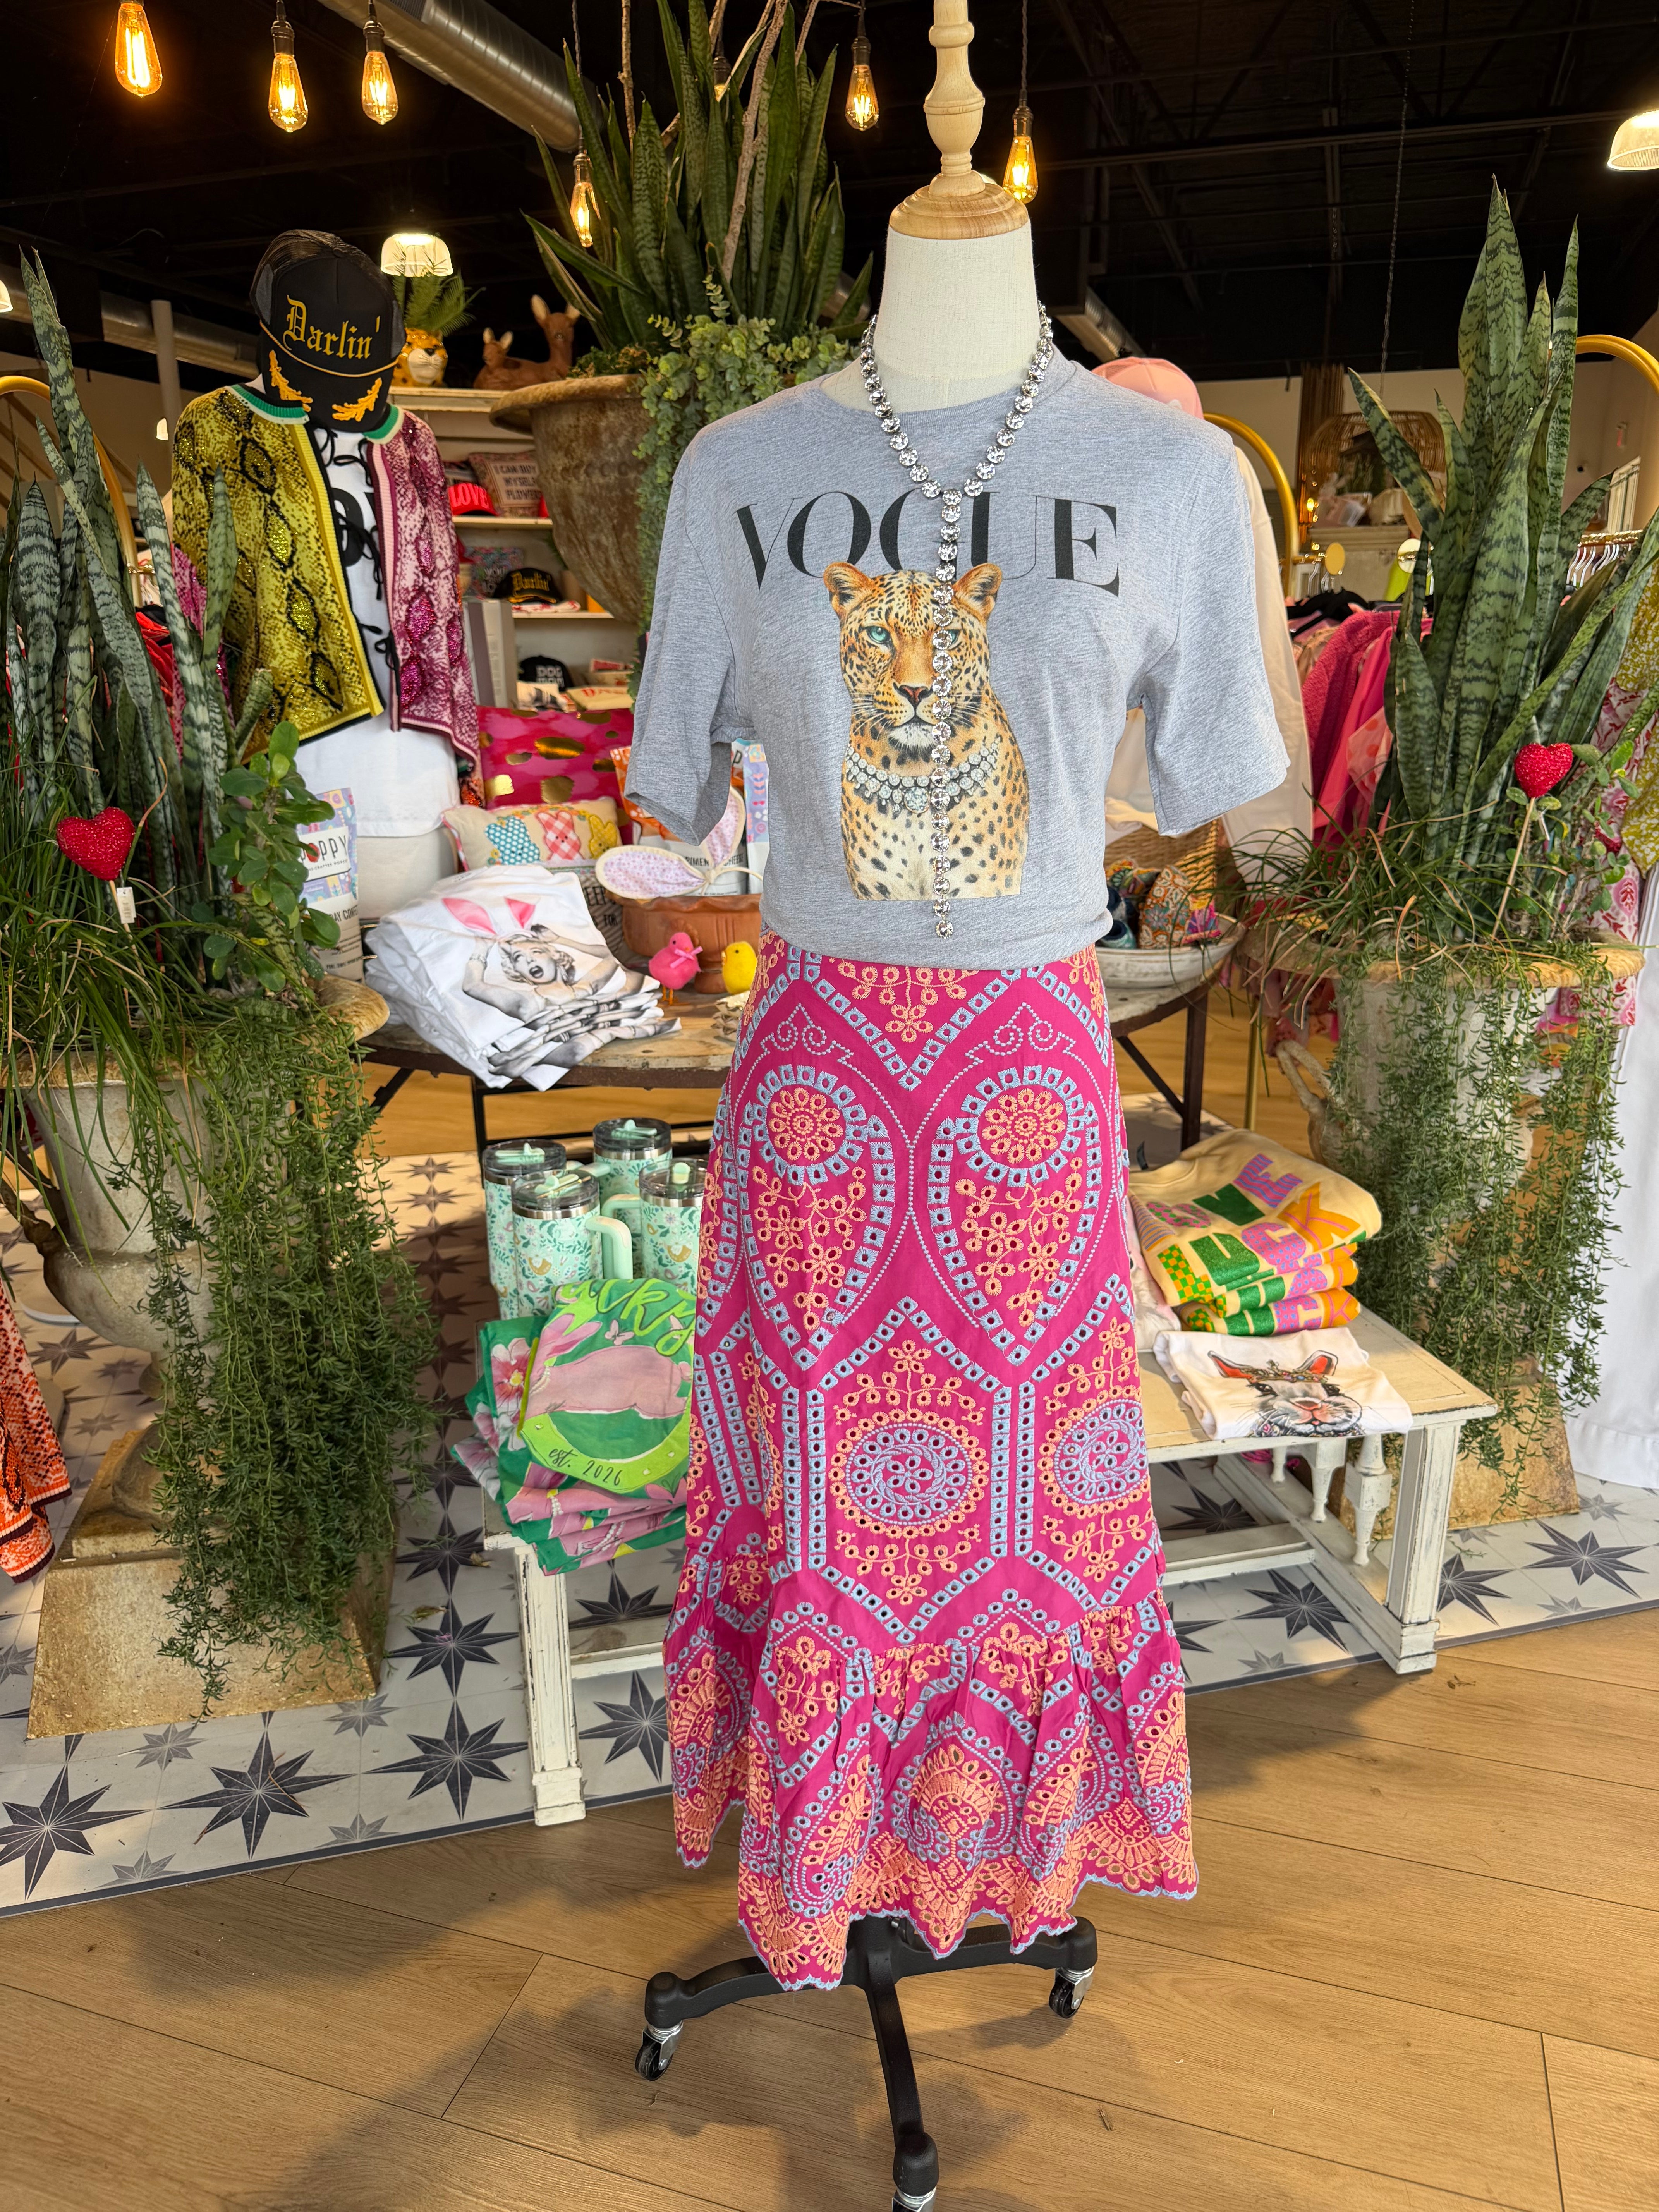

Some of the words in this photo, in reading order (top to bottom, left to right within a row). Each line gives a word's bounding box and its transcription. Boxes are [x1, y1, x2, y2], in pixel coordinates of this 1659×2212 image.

[282, 294, 381, 359] Darlin'
[448, 482, 489, 508] LOVE
[548, 1449, 579, 1468] est.
[582, 1460, 622, 1486] 2026
